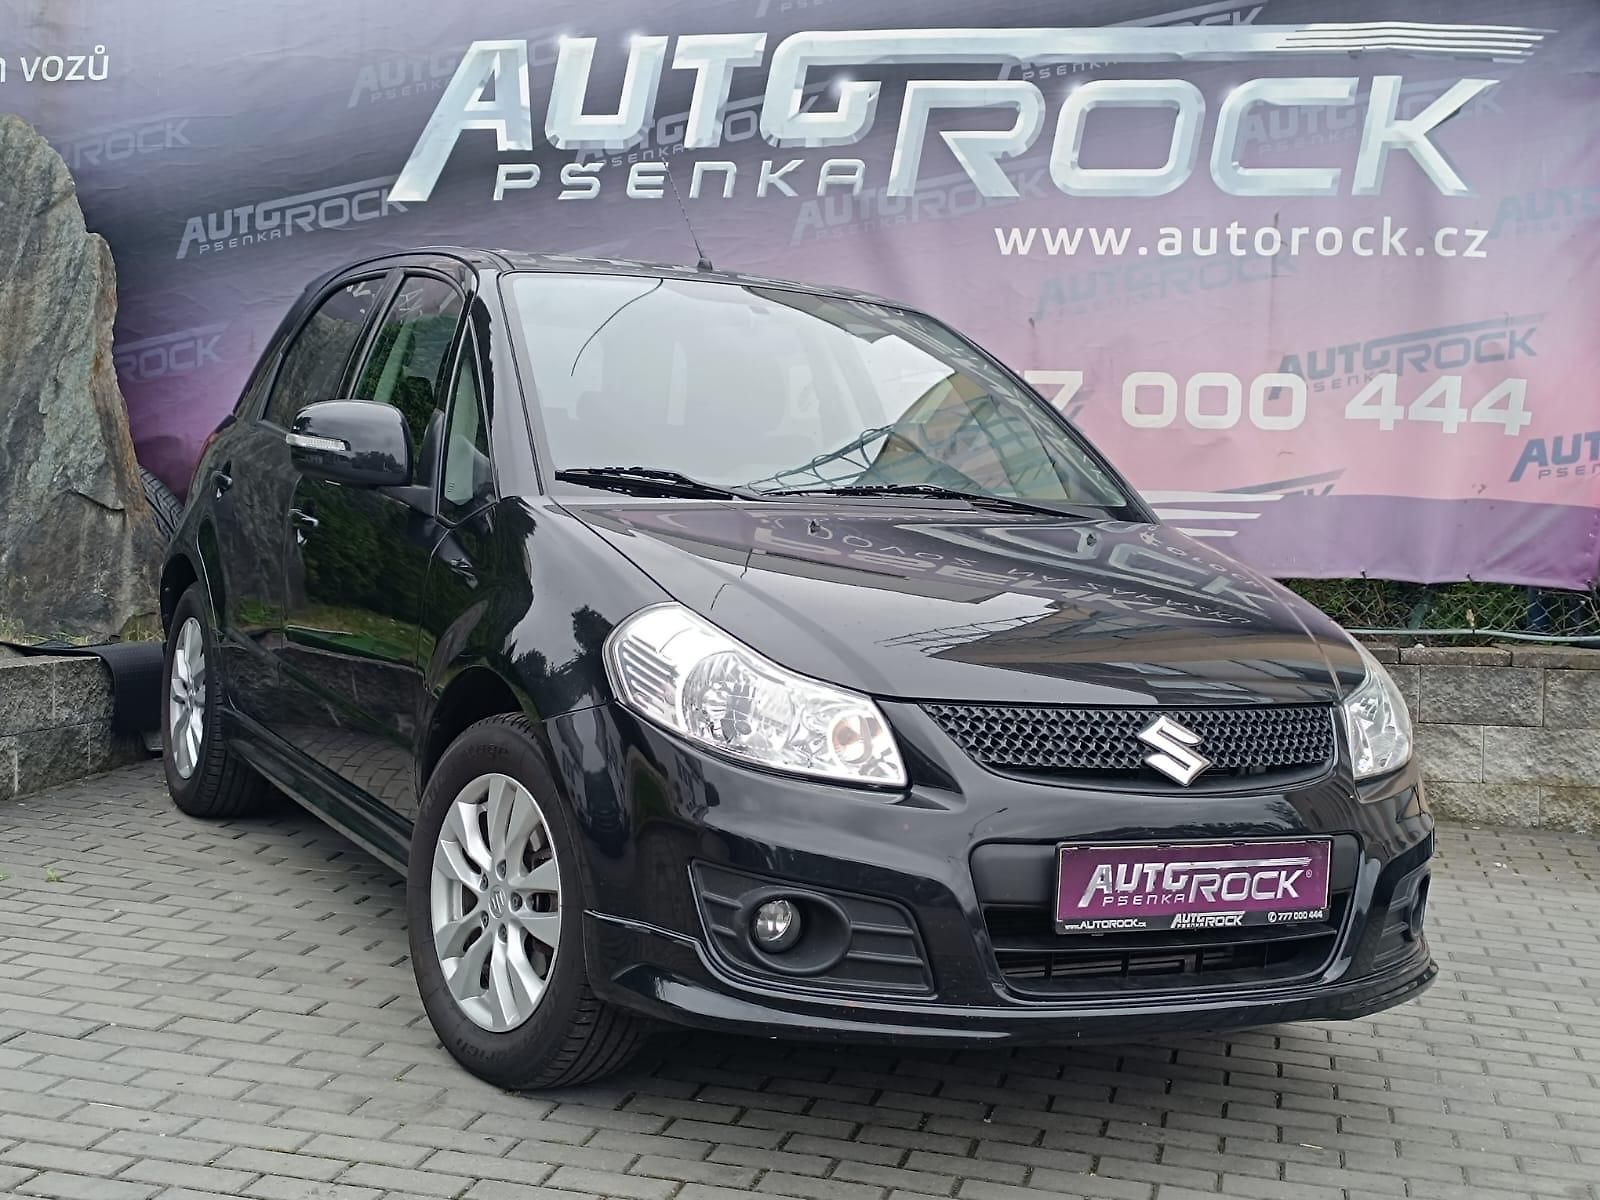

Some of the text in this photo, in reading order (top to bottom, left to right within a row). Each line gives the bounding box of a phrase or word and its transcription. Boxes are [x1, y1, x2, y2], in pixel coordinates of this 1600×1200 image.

[20, 44, 110, 82] vozů
[994, 216, 1489, 258] www.autorock.cz
[1122, 371, 1307, 431] 000
[1344, 374, 1532, 436] 444
